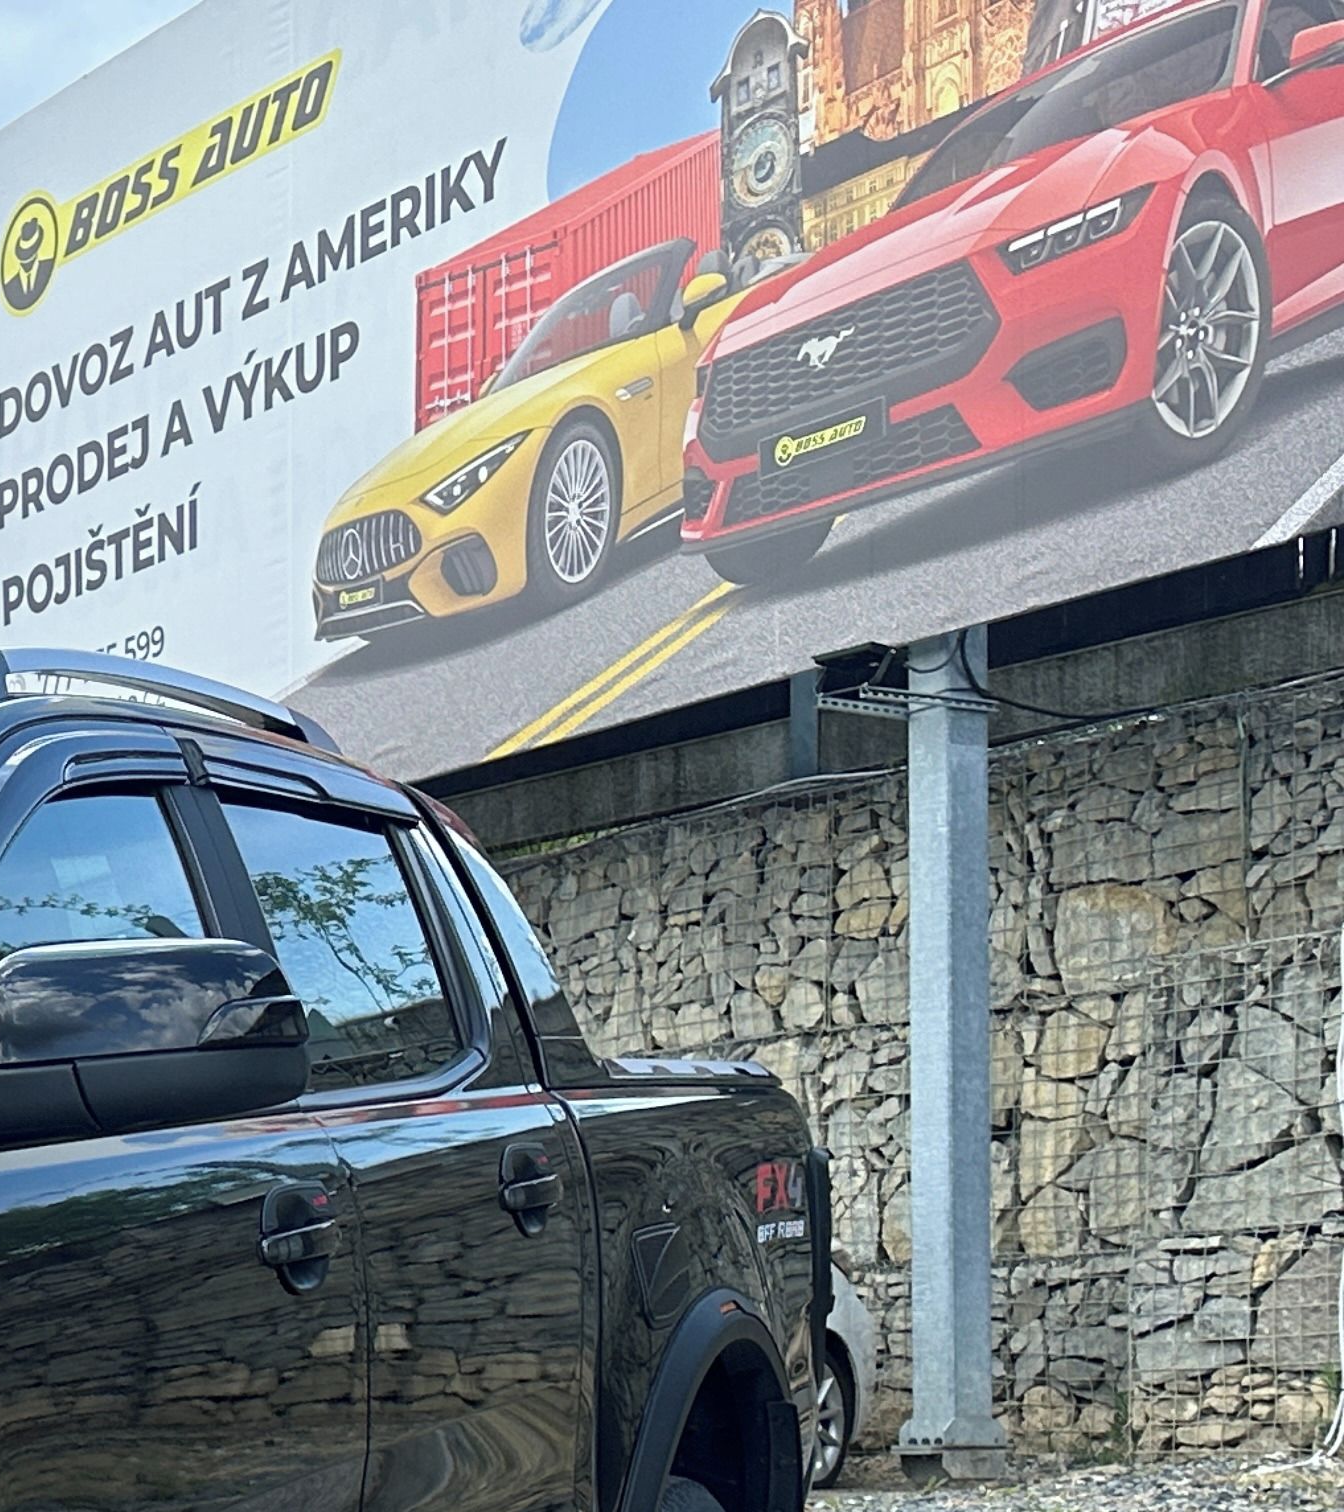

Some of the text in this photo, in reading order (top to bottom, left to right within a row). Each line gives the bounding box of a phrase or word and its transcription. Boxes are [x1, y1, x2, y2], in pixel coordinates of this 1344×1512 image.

[64, 60, 334, 257] BOSS AUTO
[142, 276, 231, 369] AUT
[241, 257, 269, 322] Z
[280, 136, 508, 303] AMERIKY
[160, 399, 194, 458] A
[201, 320, 361, 435] VÝKUP
[1, 482, 202, 627] POJIŠTĚNÍ
[124, 625, 165, 662] 599
[756, 1162, 803, 1213] FX4
